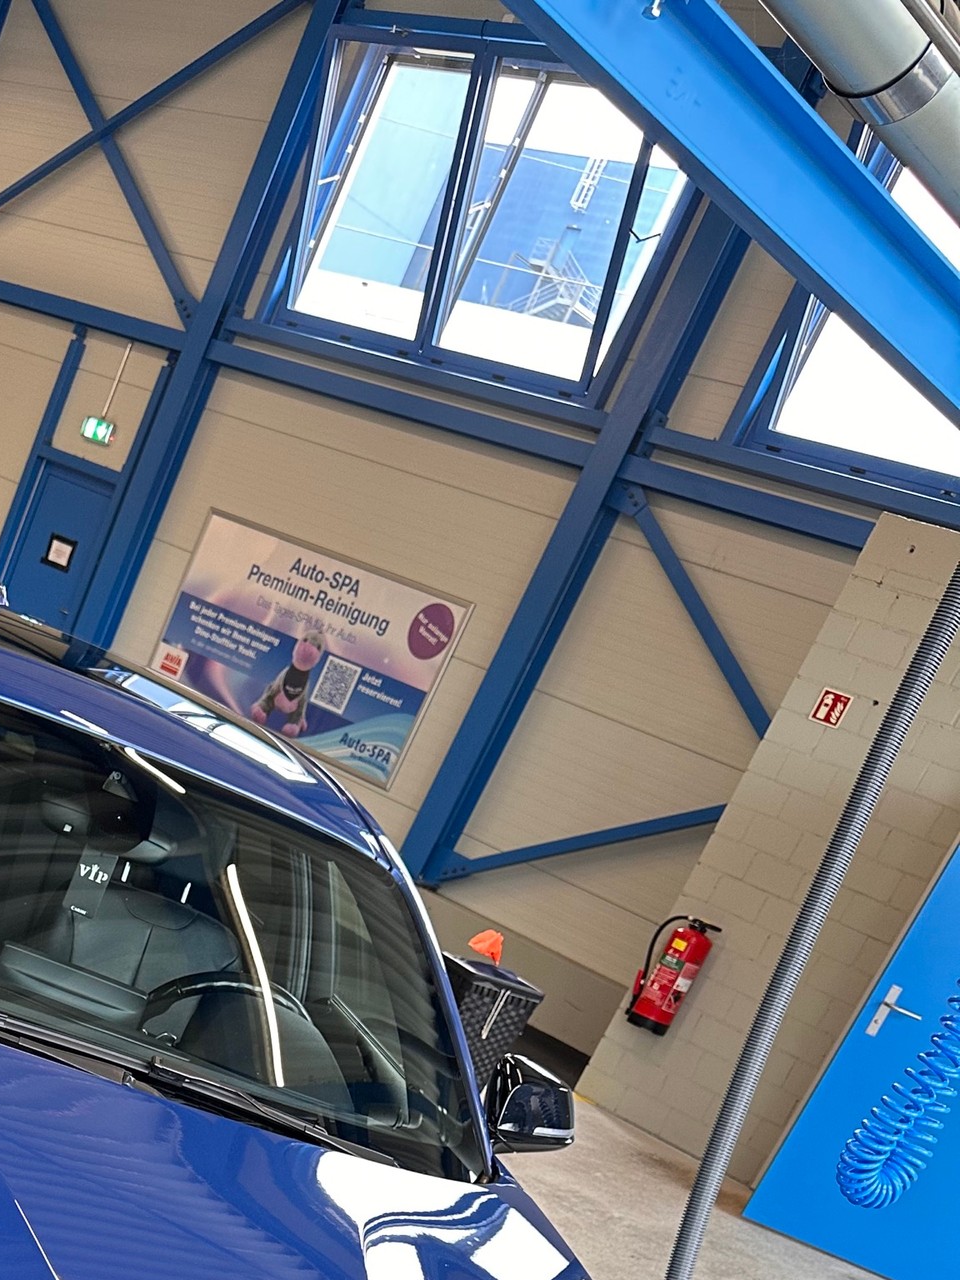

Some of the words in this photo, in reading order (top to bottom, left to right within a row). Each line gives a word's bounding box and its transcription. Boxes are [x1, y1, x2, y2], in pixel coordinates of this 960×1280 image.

[289, 557, 360, 598] Auto-SPA
[247, 564, 390, 637] Premium-Reinigung
[362, 672, 382, 688] Jetzt
[339, 732, 391, 765] Auto-SPA
